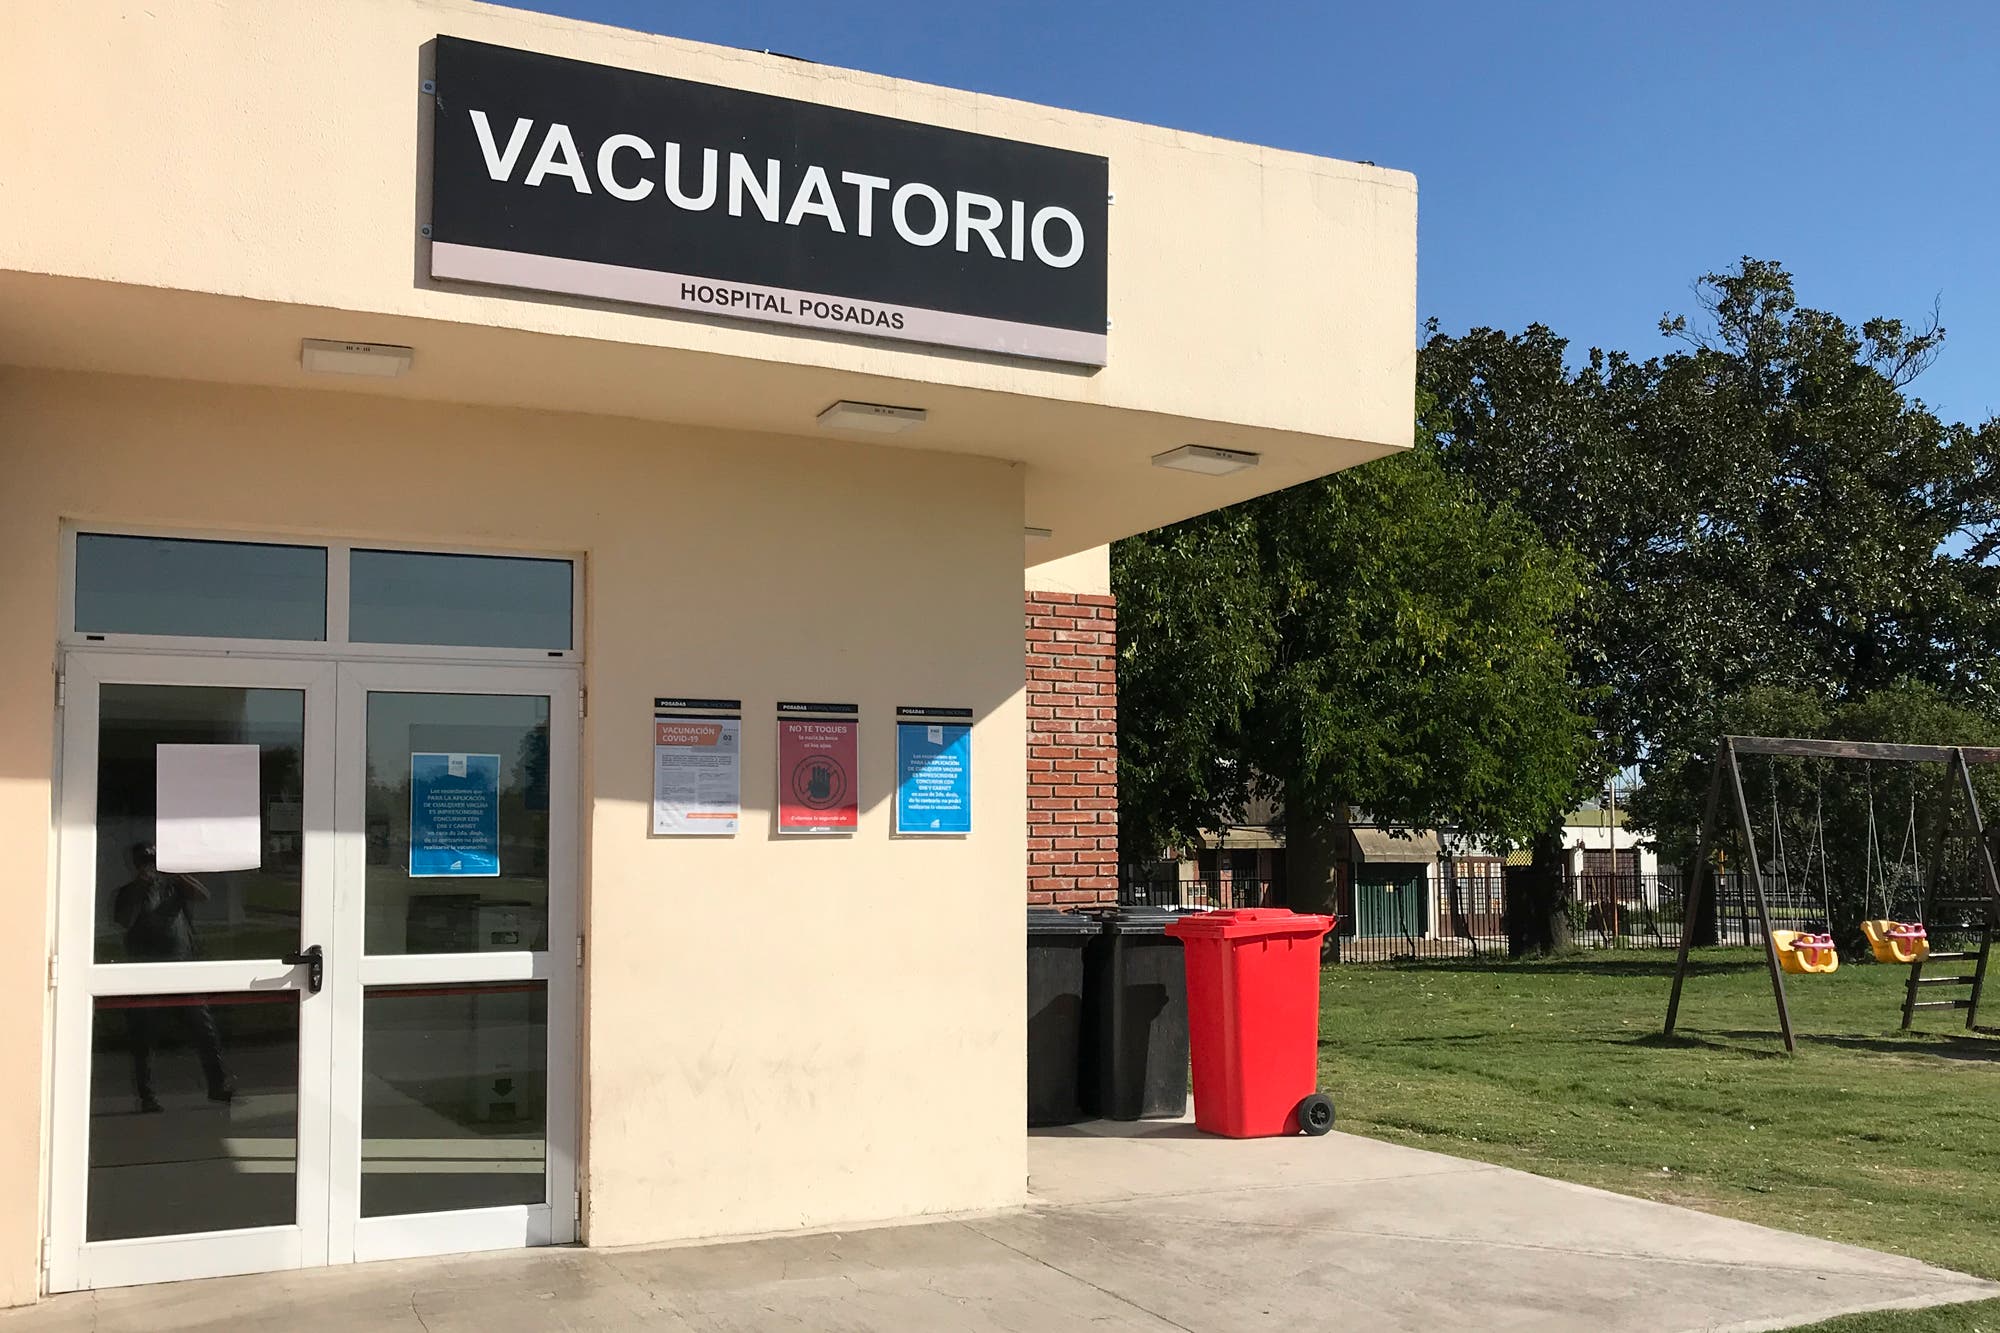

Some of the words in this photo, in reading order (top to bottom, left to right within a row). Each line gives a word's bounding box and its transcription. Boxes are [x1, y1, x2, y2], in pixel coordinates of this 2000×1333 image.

[469, 110, 1085, 268] VACUNATORIO
[681, 283, 793, 314] HOSPITAL
[799, 299, 905, 330] POSADAS
[662, 726, 715, 735] VACUNACIÓN
[814, 725, 848, 734] TOQUES
[662, 734, 699, 742] COVID-19
